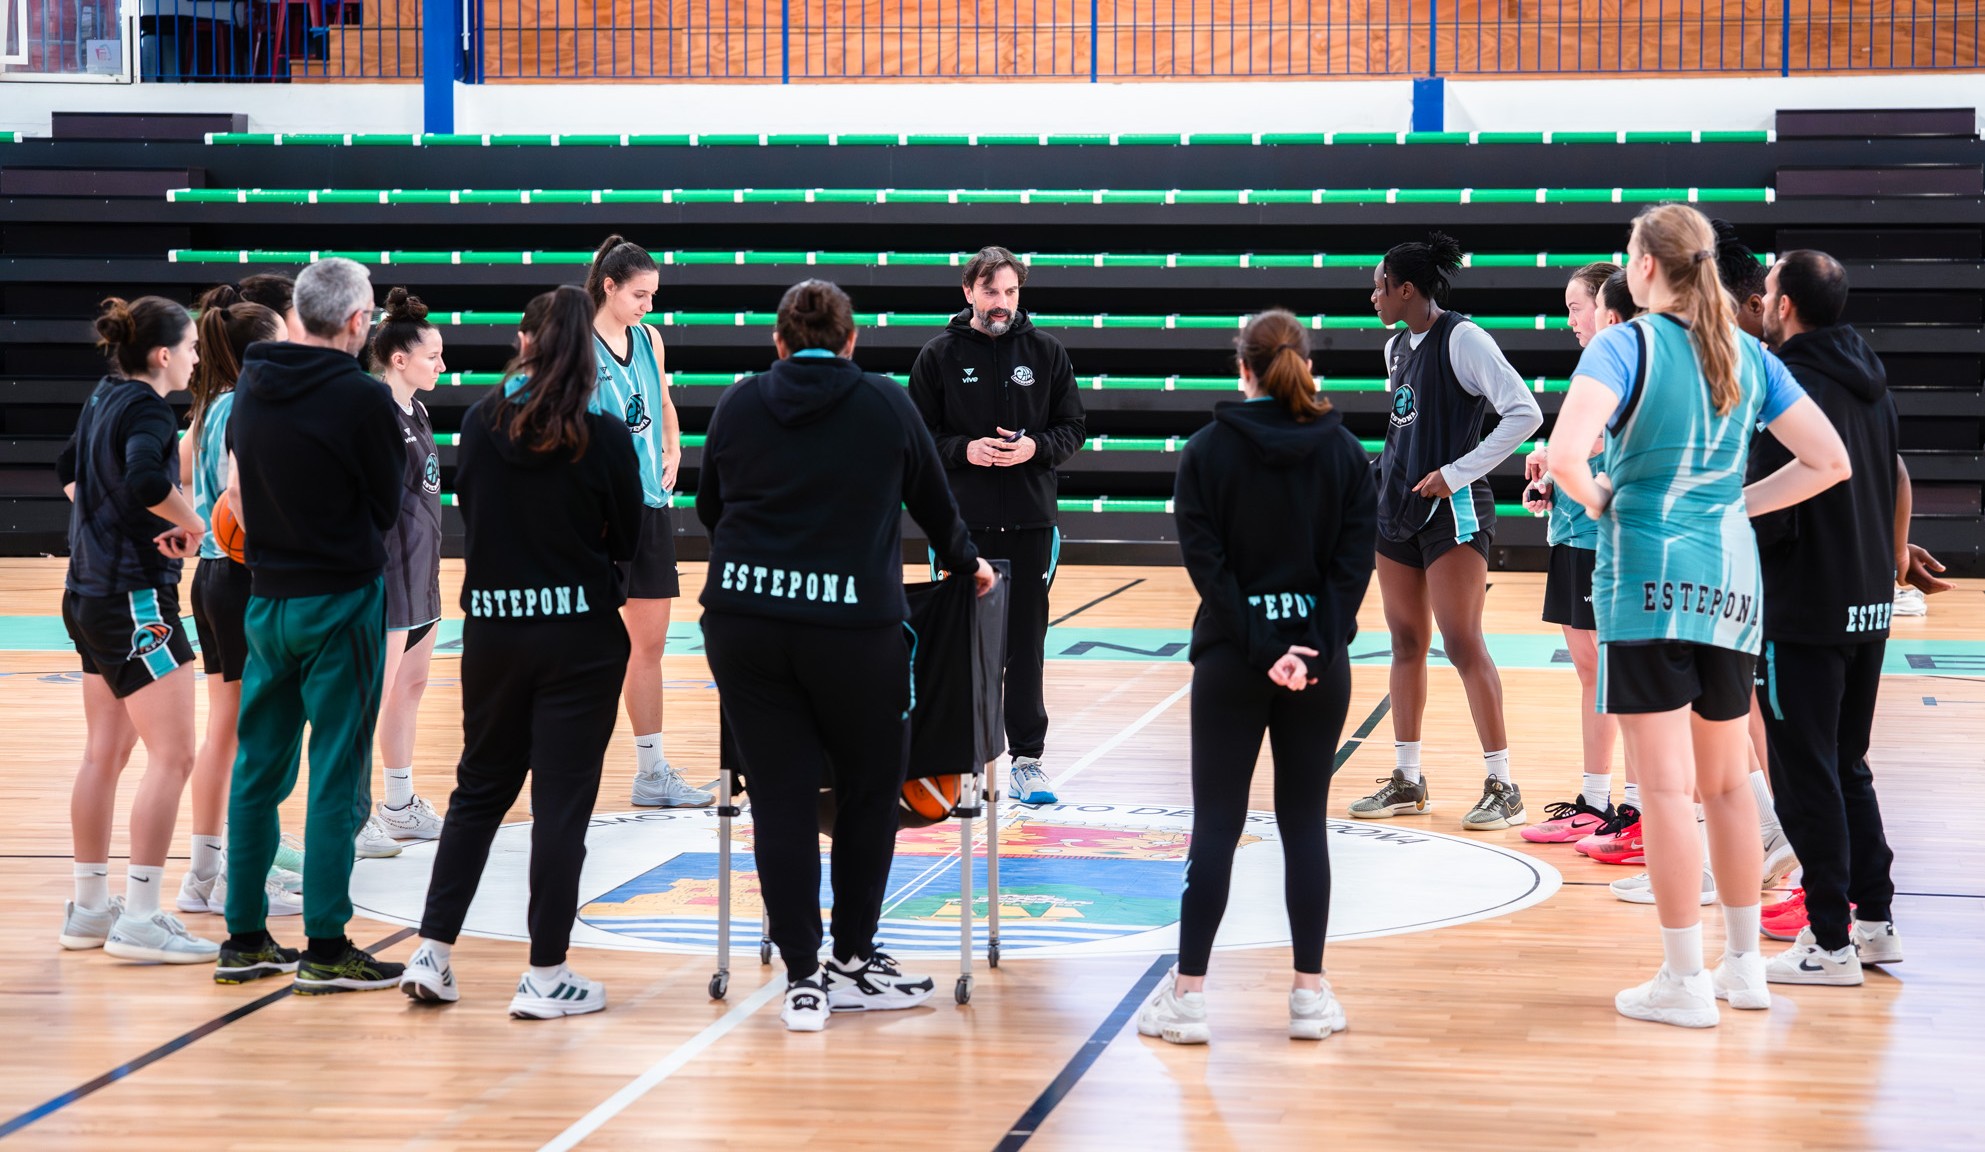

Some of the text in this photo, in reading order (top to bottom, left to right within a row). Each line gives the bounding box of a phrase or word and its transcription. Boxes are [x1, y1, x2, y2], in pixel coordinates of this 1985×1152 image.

[962, 376, 979, 384] vive
[721, 561, 859, 604] ESTEPONA
[471, 585, 590, 618] ESTEPONA
[1846, 602, 1893, 632] ESTEP
